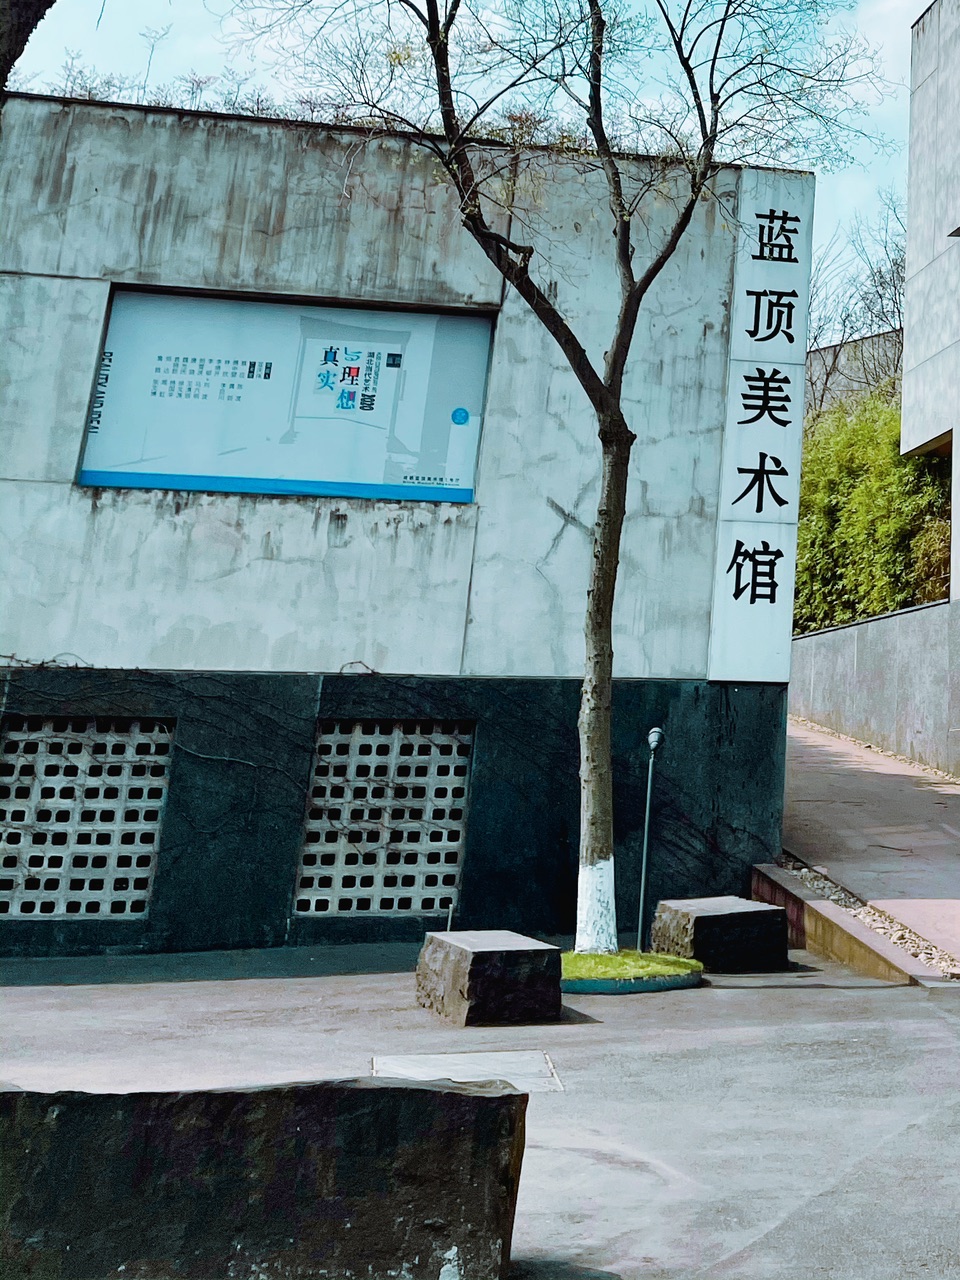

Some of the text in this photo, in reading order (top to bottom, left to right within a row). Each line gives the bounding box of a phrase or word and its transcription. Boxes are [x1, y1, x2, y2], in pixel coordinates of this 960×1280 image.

[725, 208, 801, 605] 蓝顶美术馆
